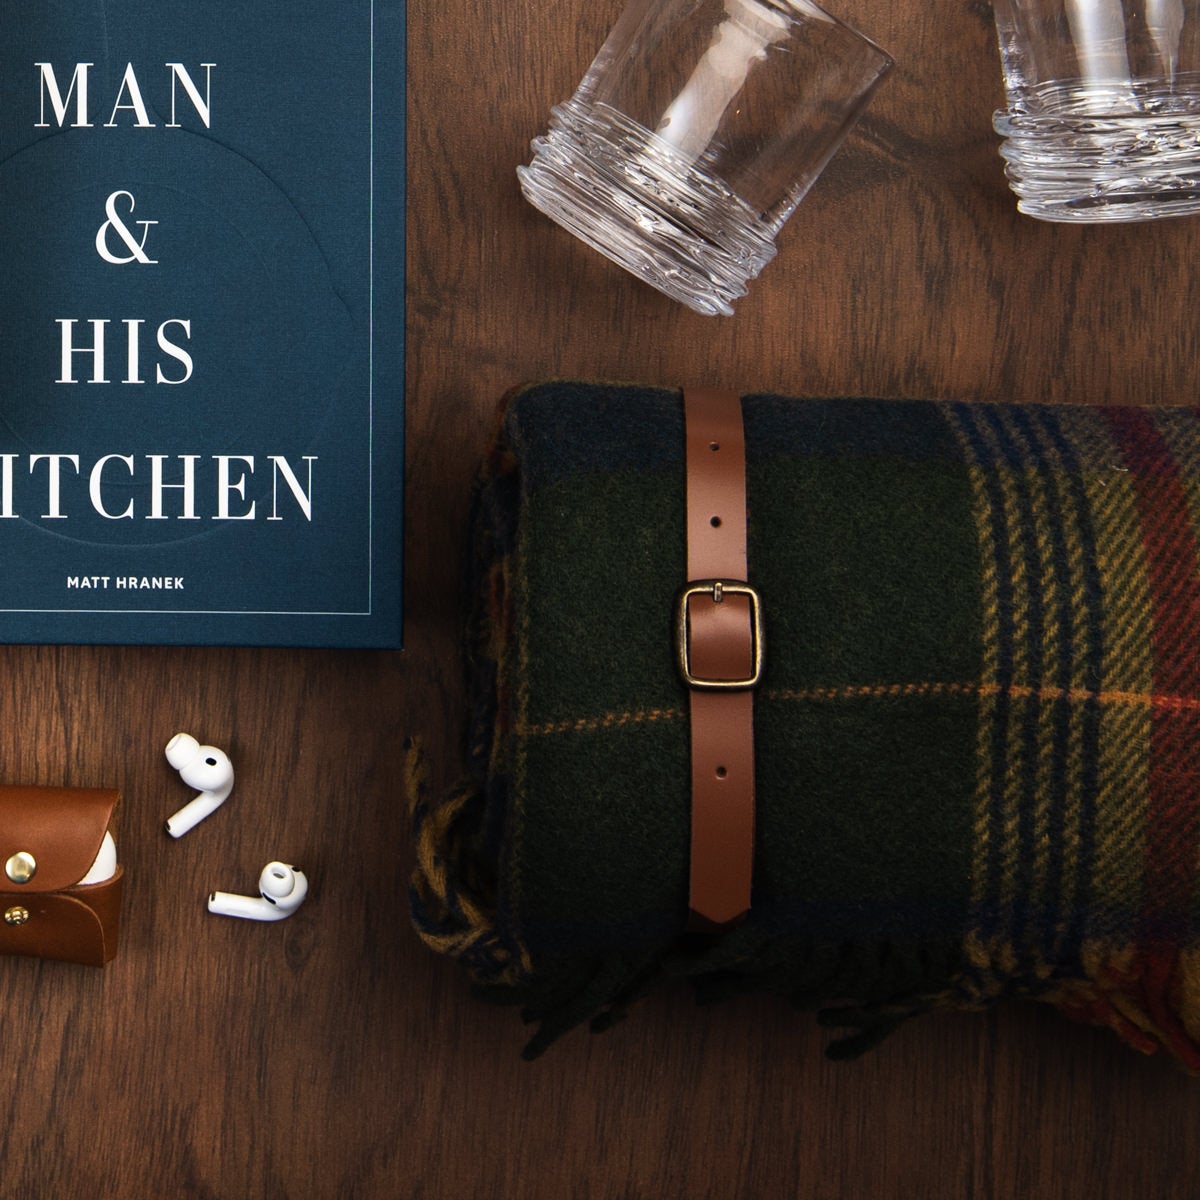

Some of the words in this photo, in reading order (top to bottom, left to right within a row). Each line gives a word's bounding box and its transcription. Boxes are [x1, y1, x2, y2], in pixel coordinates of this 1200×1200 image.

[34, 61, 217, 129] MAN
[95, 190, 159, 265] &
[54, 318, 194, 385] HIS
[67, 576, 111, 589] MATT
[116, 576, 184, 590] HRANEK
